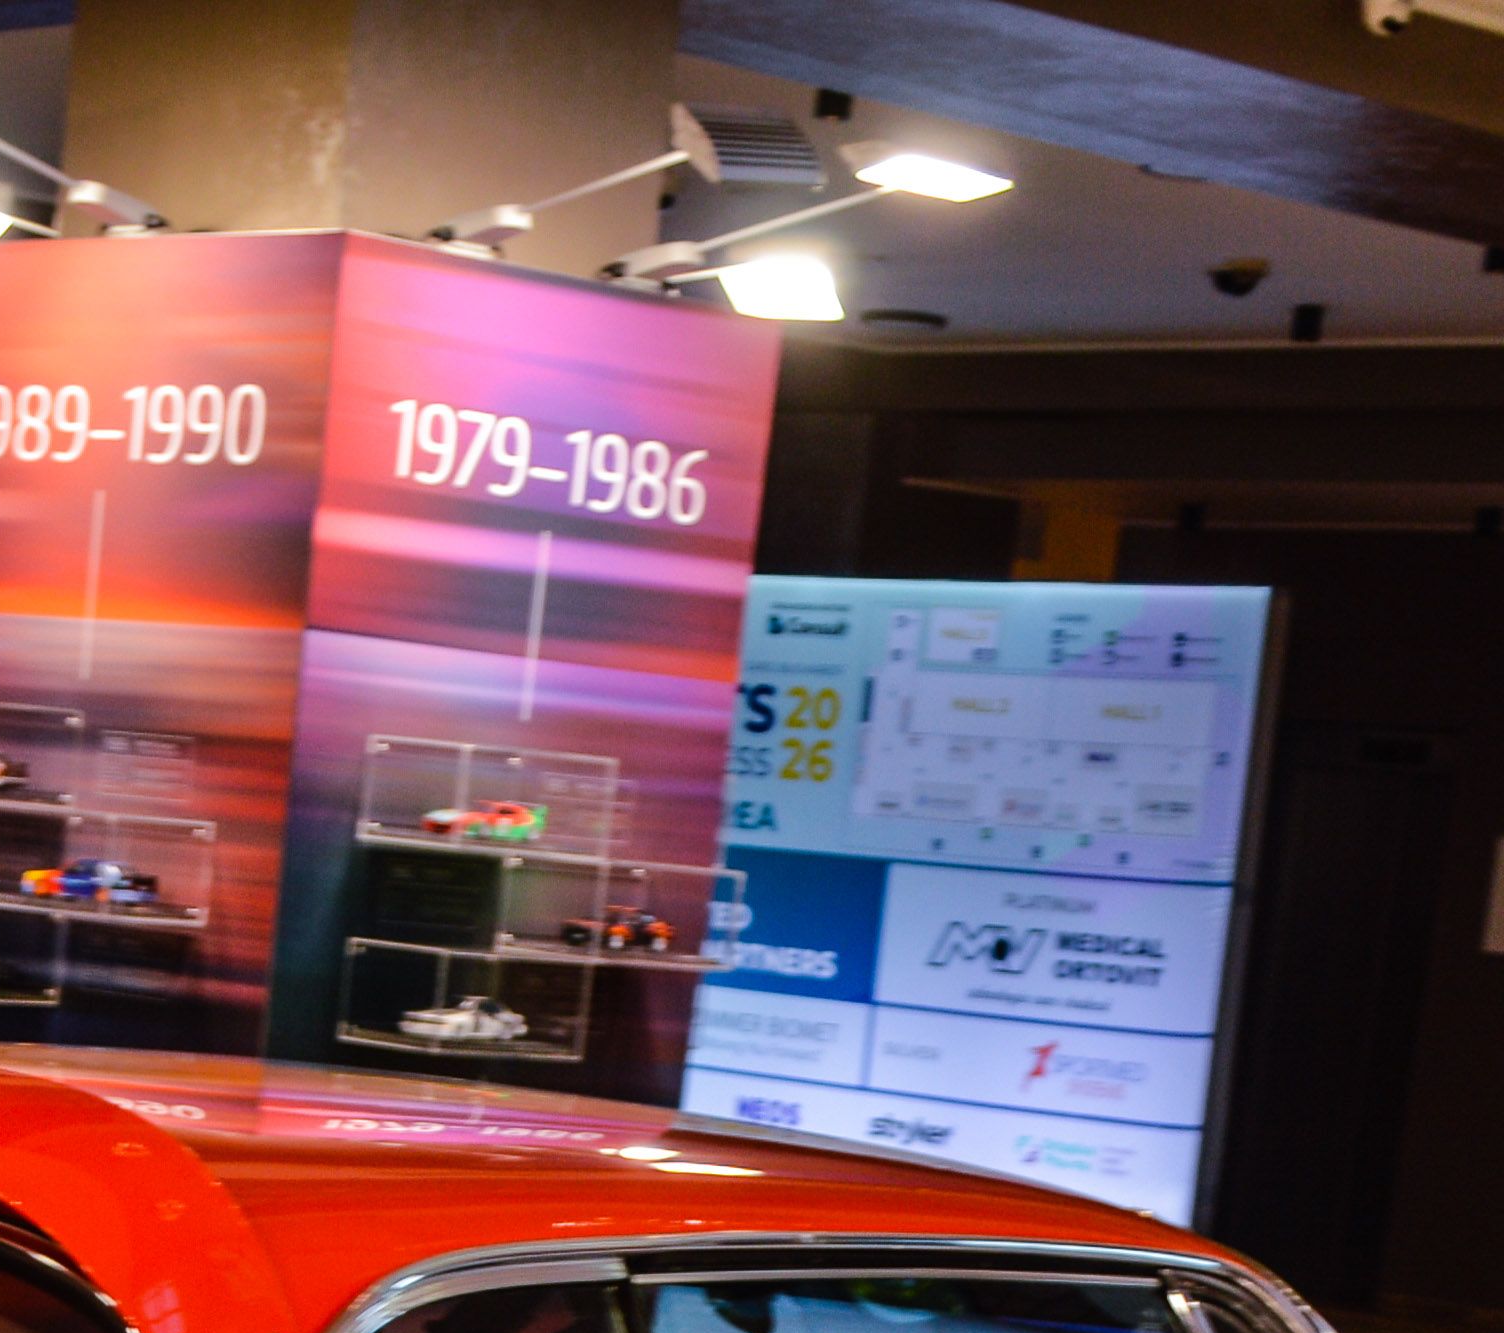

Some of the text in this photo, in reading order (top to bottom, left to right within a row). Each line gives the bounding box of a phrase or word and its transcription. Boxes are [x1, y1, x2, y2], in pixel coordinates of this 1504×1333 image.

[736, 682, 777, 734] S
[778, 737, 834, 783] 26
[1055, 929, 1167, 960] MEDICAL
